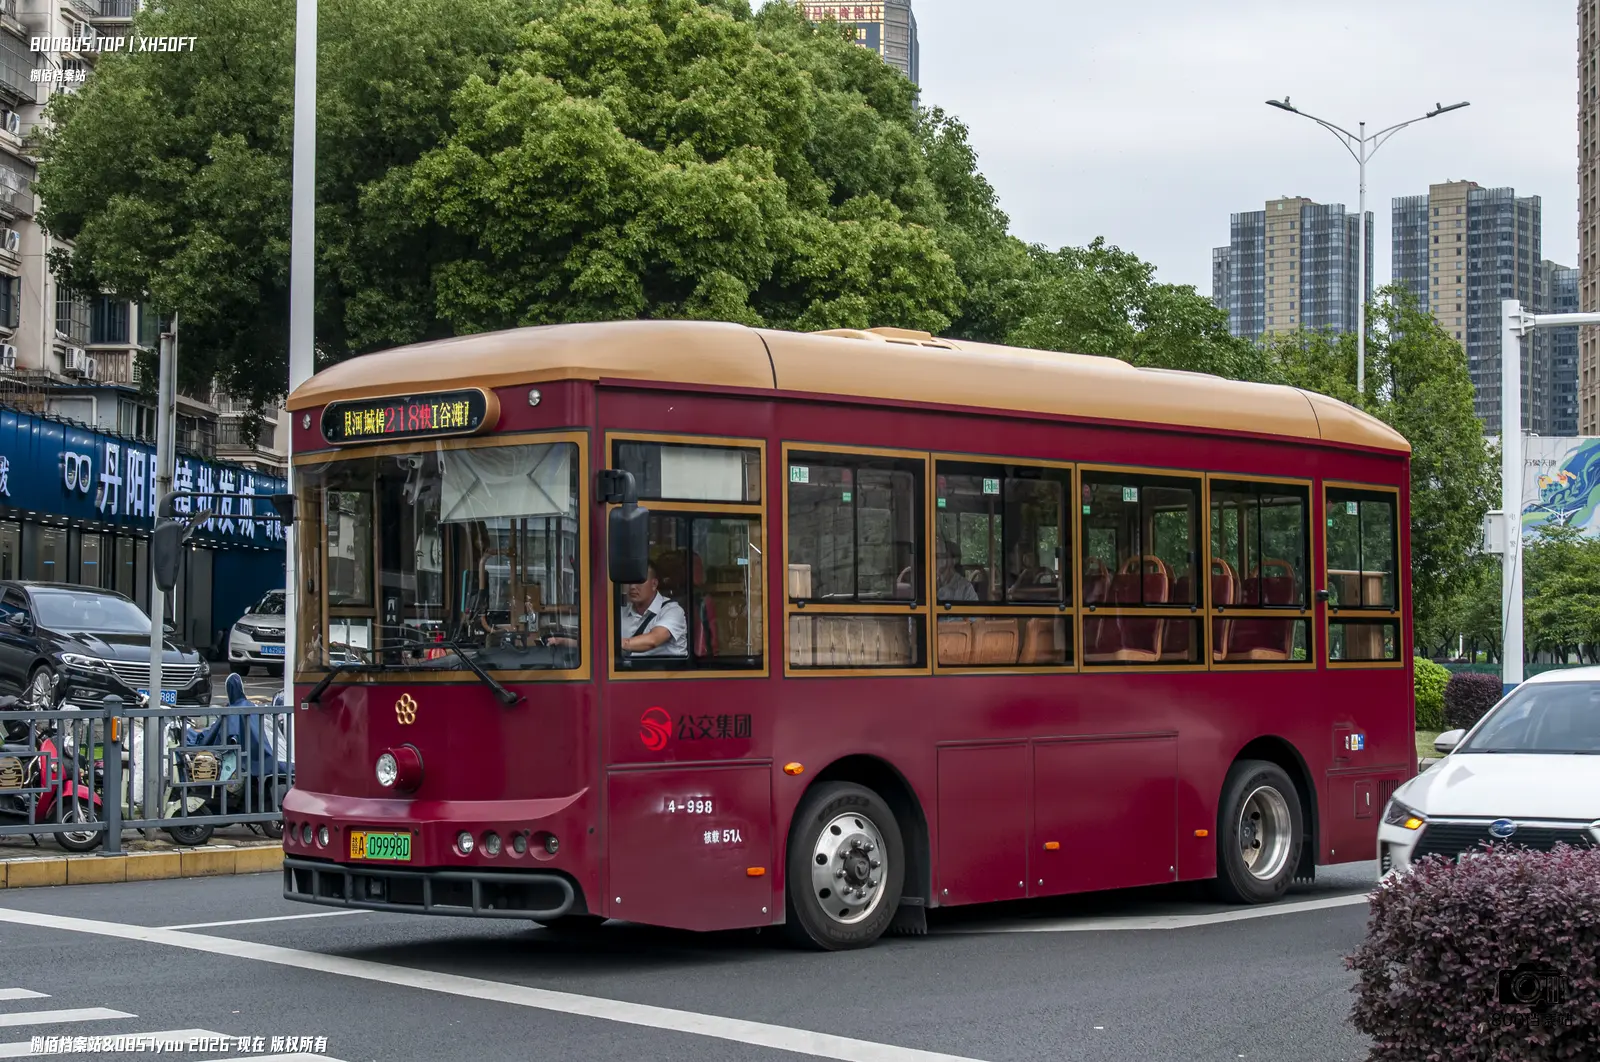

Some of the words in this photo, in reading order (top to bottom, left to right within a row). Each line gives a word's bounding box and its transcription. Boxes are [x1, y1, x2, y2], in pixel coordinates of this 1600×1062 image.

[678, 714, 752, 740] 公交集团
[668, 800, 713, 814] 4-998
[723, 829, 742, 843] 51人
